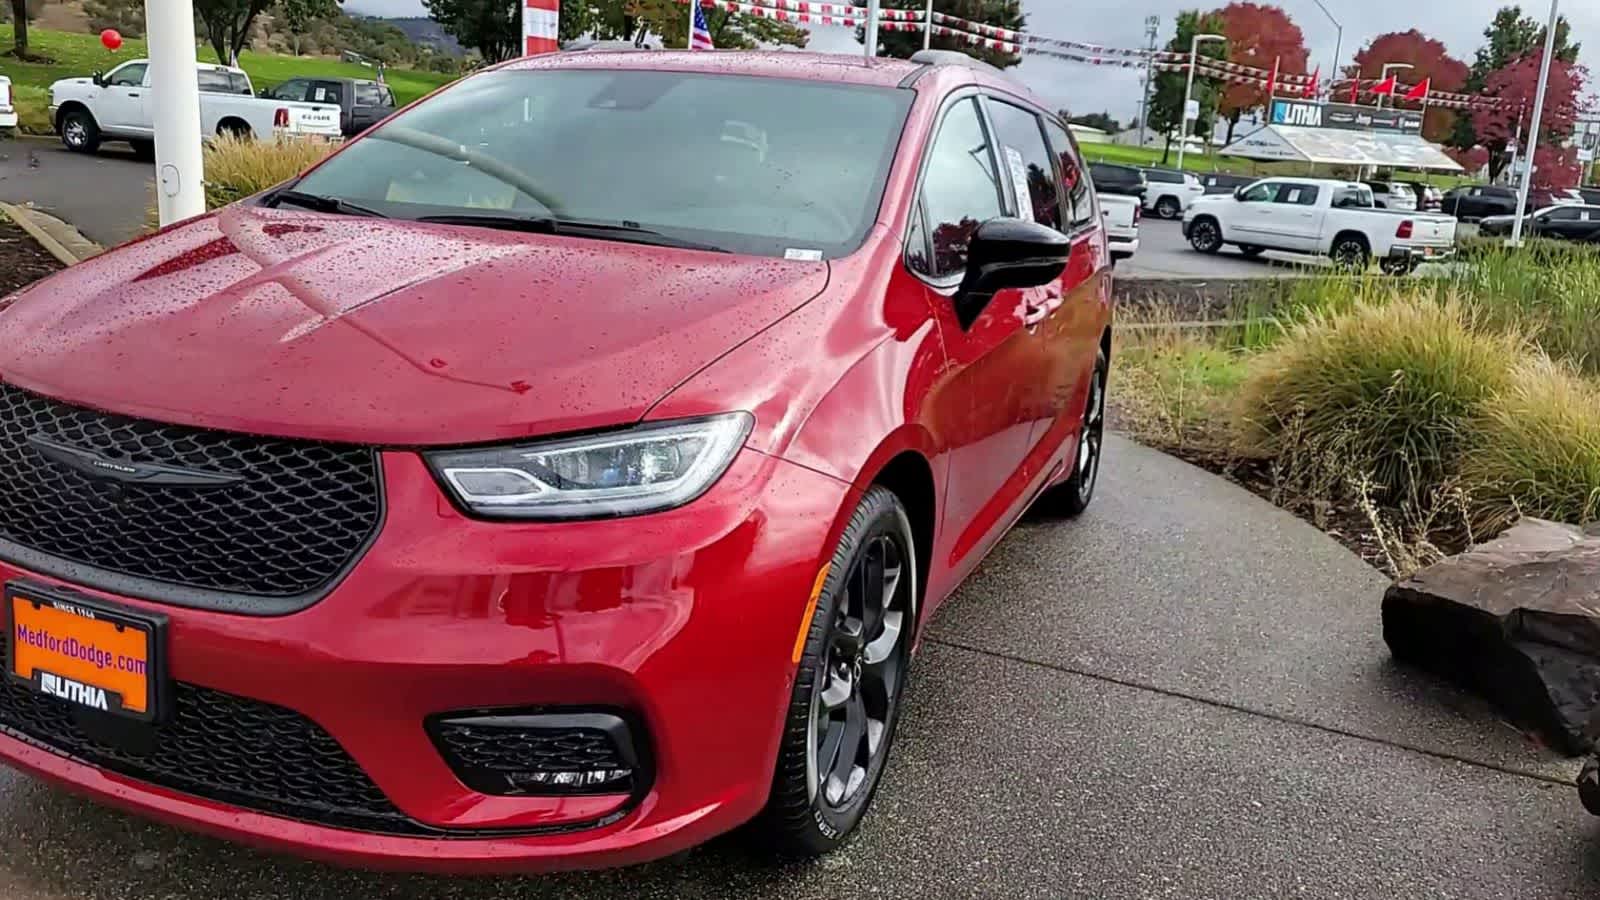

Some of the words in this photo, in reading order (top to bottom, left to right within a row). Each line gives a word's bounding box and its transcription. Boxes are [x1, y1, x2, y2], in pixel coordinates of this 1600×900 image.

[1285, 103, 1322, 126] LITHIA
[53, 601, 76, 615] SINCE
[18, 625, 147, 674] MedfordDodge.com
[56, 675, 109, 711] LITHIA
